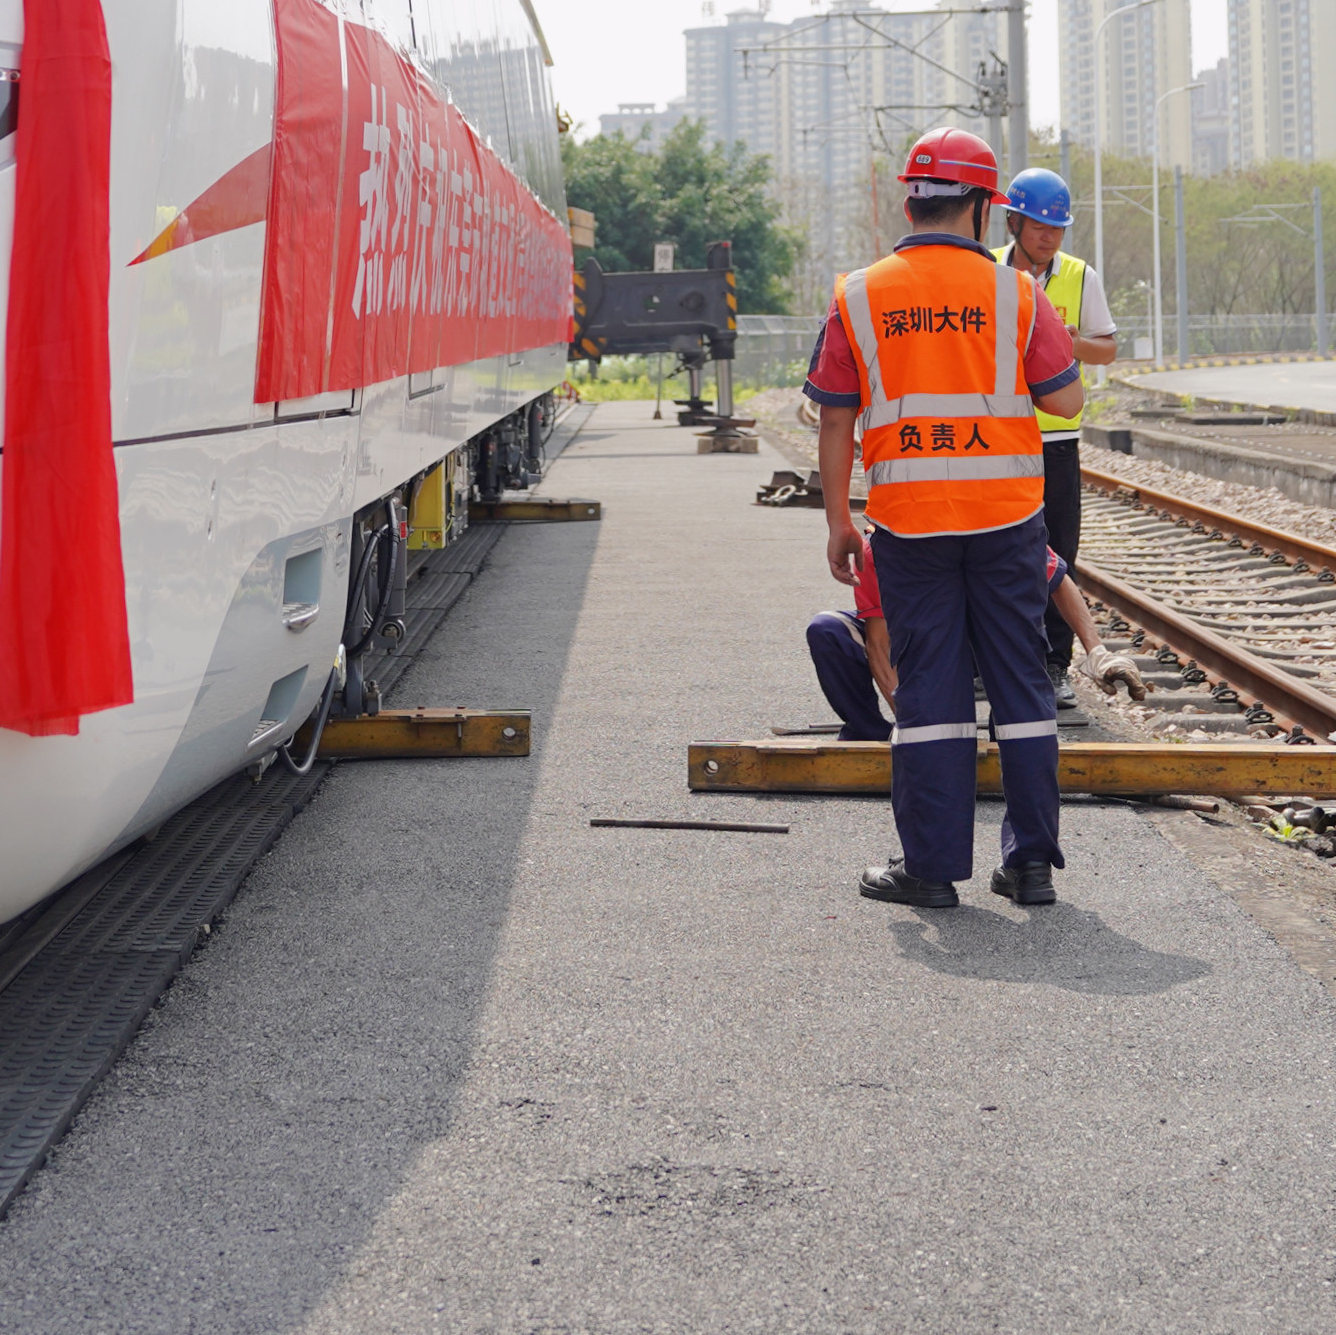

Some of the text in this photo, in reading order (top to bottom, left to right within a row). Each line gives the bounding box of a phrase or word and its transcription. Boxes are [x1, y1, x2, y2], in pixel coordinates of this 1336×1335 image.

[882, 306, 986, 338] 深圳大件
[898, 423, 990, 453] 负责人
